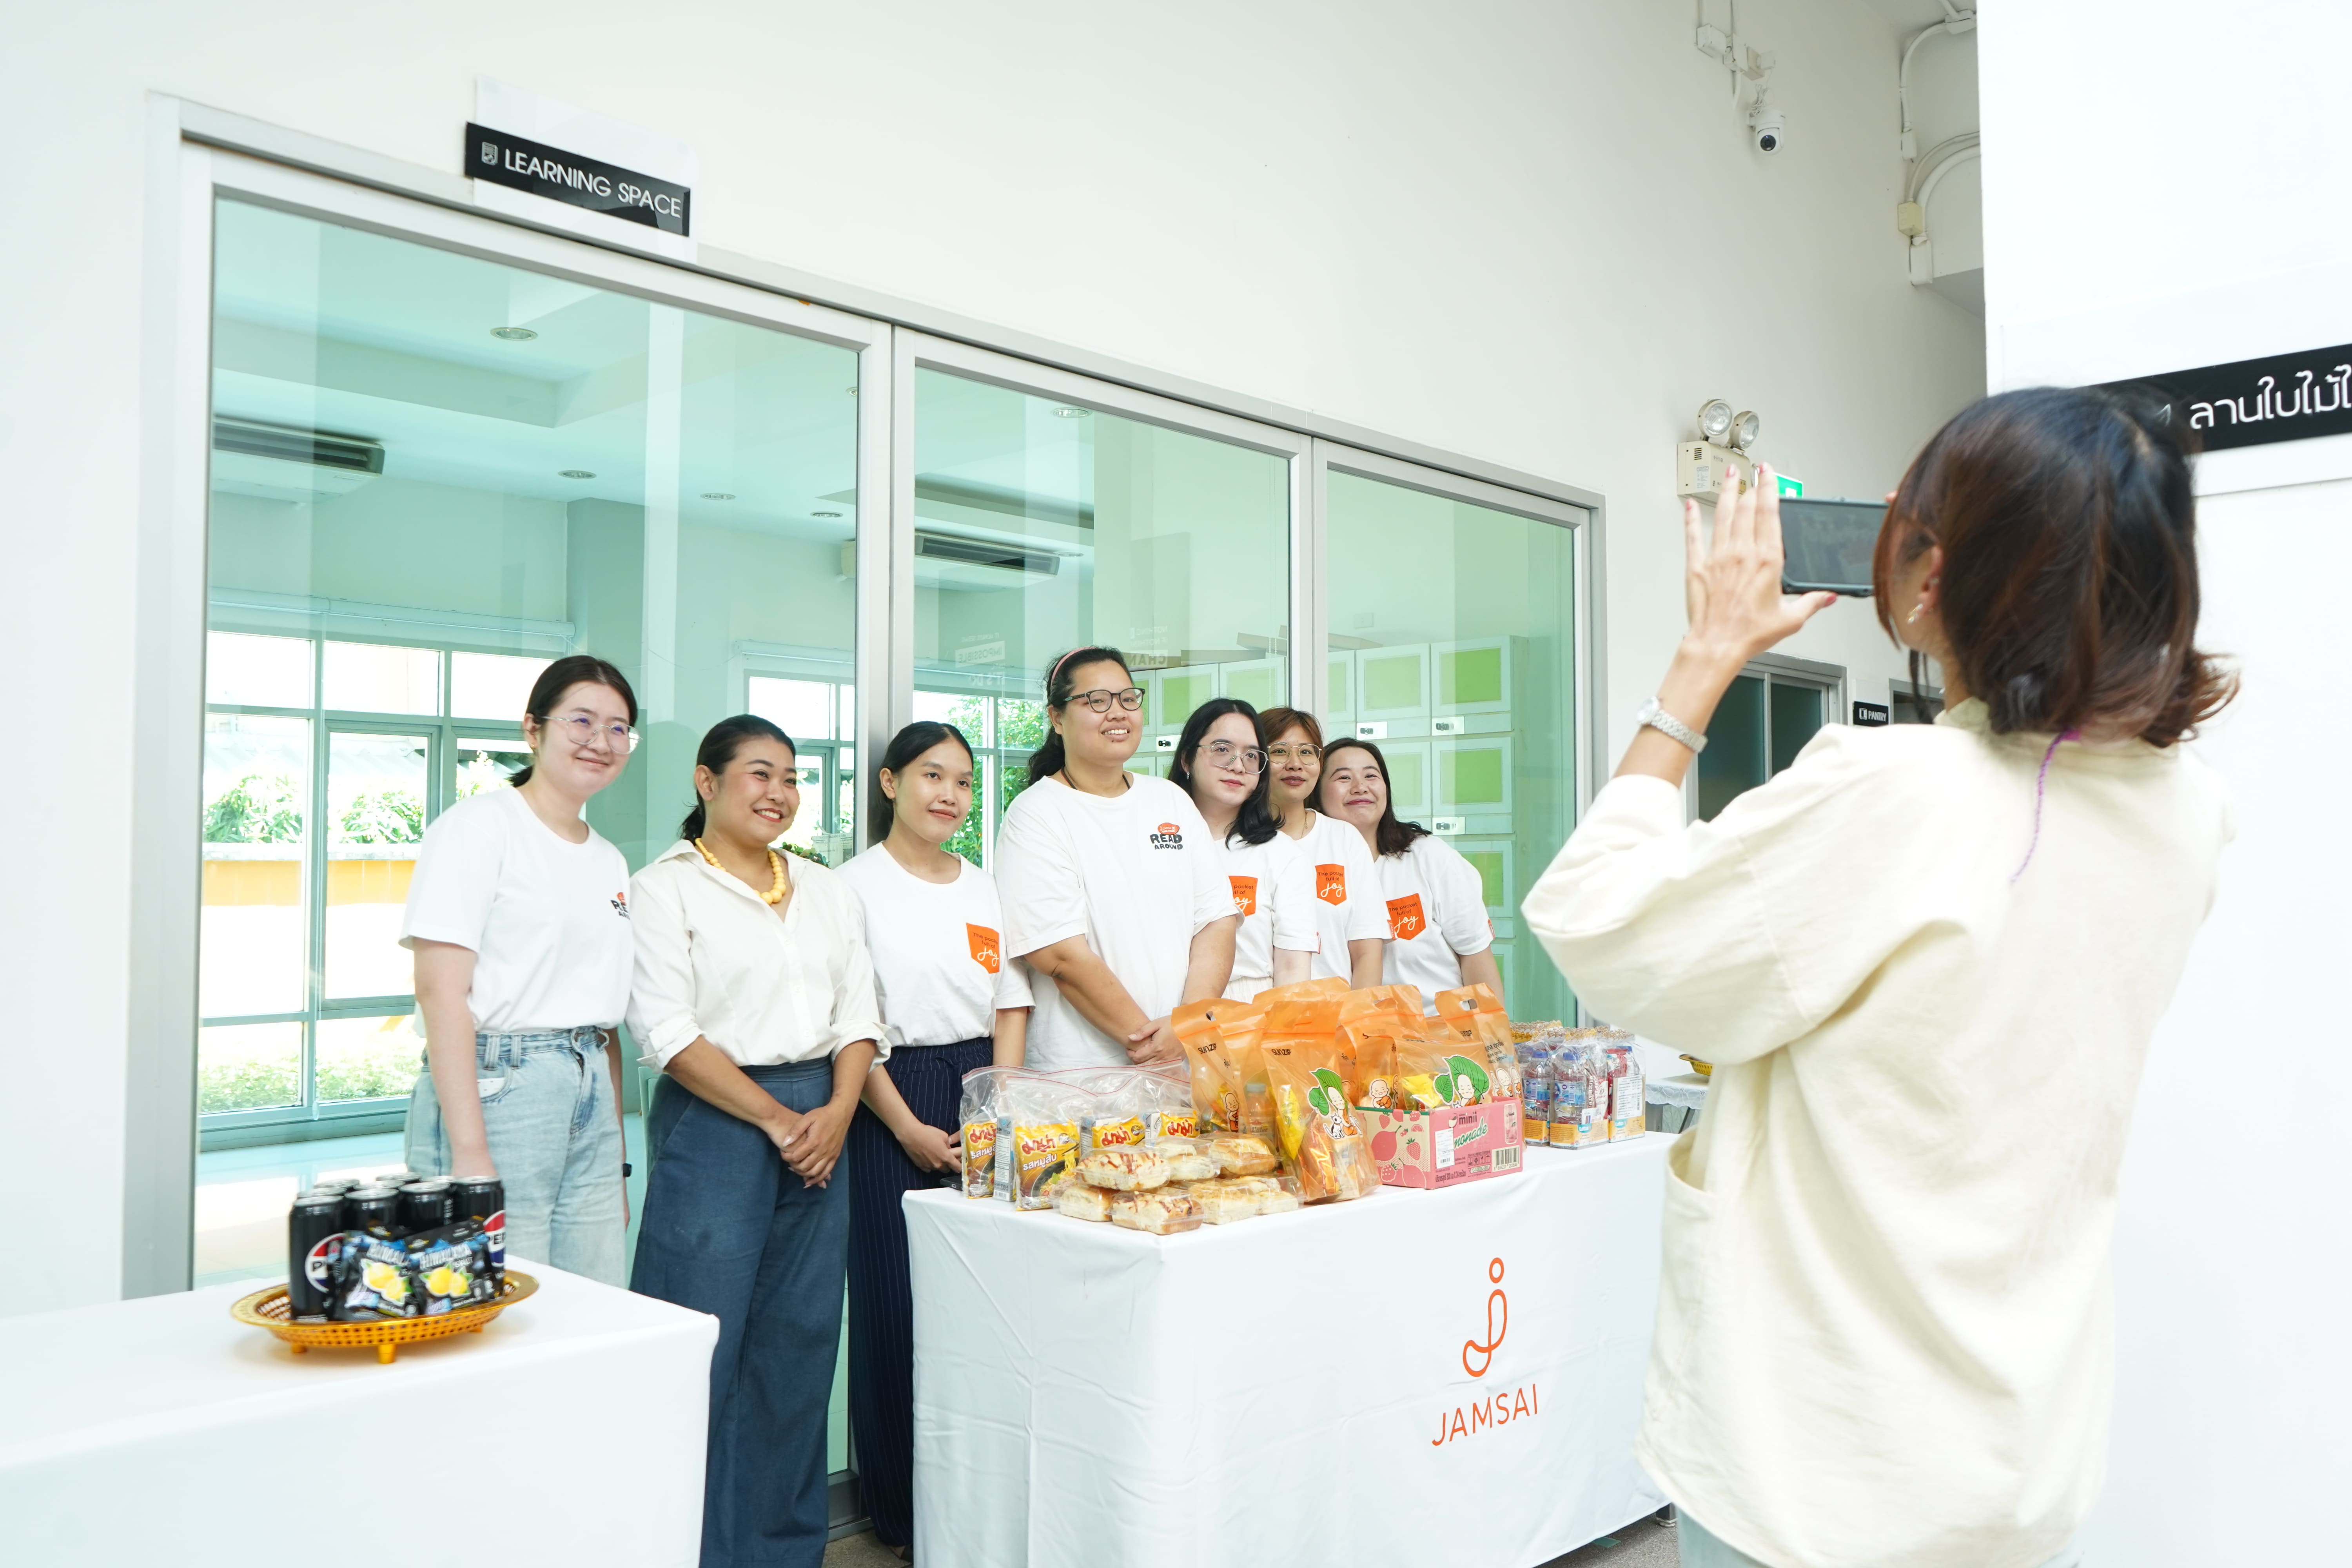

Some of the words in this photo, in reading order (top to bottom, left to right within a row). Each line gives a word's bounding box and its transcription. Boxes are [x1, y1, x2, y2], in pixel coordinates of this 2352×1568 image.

[505, 149, 611, 197] LEARNING
[617, 182, 682, 218] SPACE
[1868, 710, 1886, 722] PANTRY
[1150, 834, 1182, 844] READ
[1320, 882, 1344, 898] joy
[1234, 897, 1252, 911] oy
[1399, 902, 1417, 911] pocket
[1394, 915, 1419, 934] joy
[977, 946, 1000, 967] joy
[1459, 1111, 1477, 1125] minii
[1167, 1119, 1192, 1136] มาม่า
[1022, 1134, 1056, 1154] มาม่า
[1101, 1126, 1131, 1147] มาม่า
[1022, 1153, 1058, 1171] รสหมูสับ
[1432, 1383, 1538, 1446] JAMSAI
